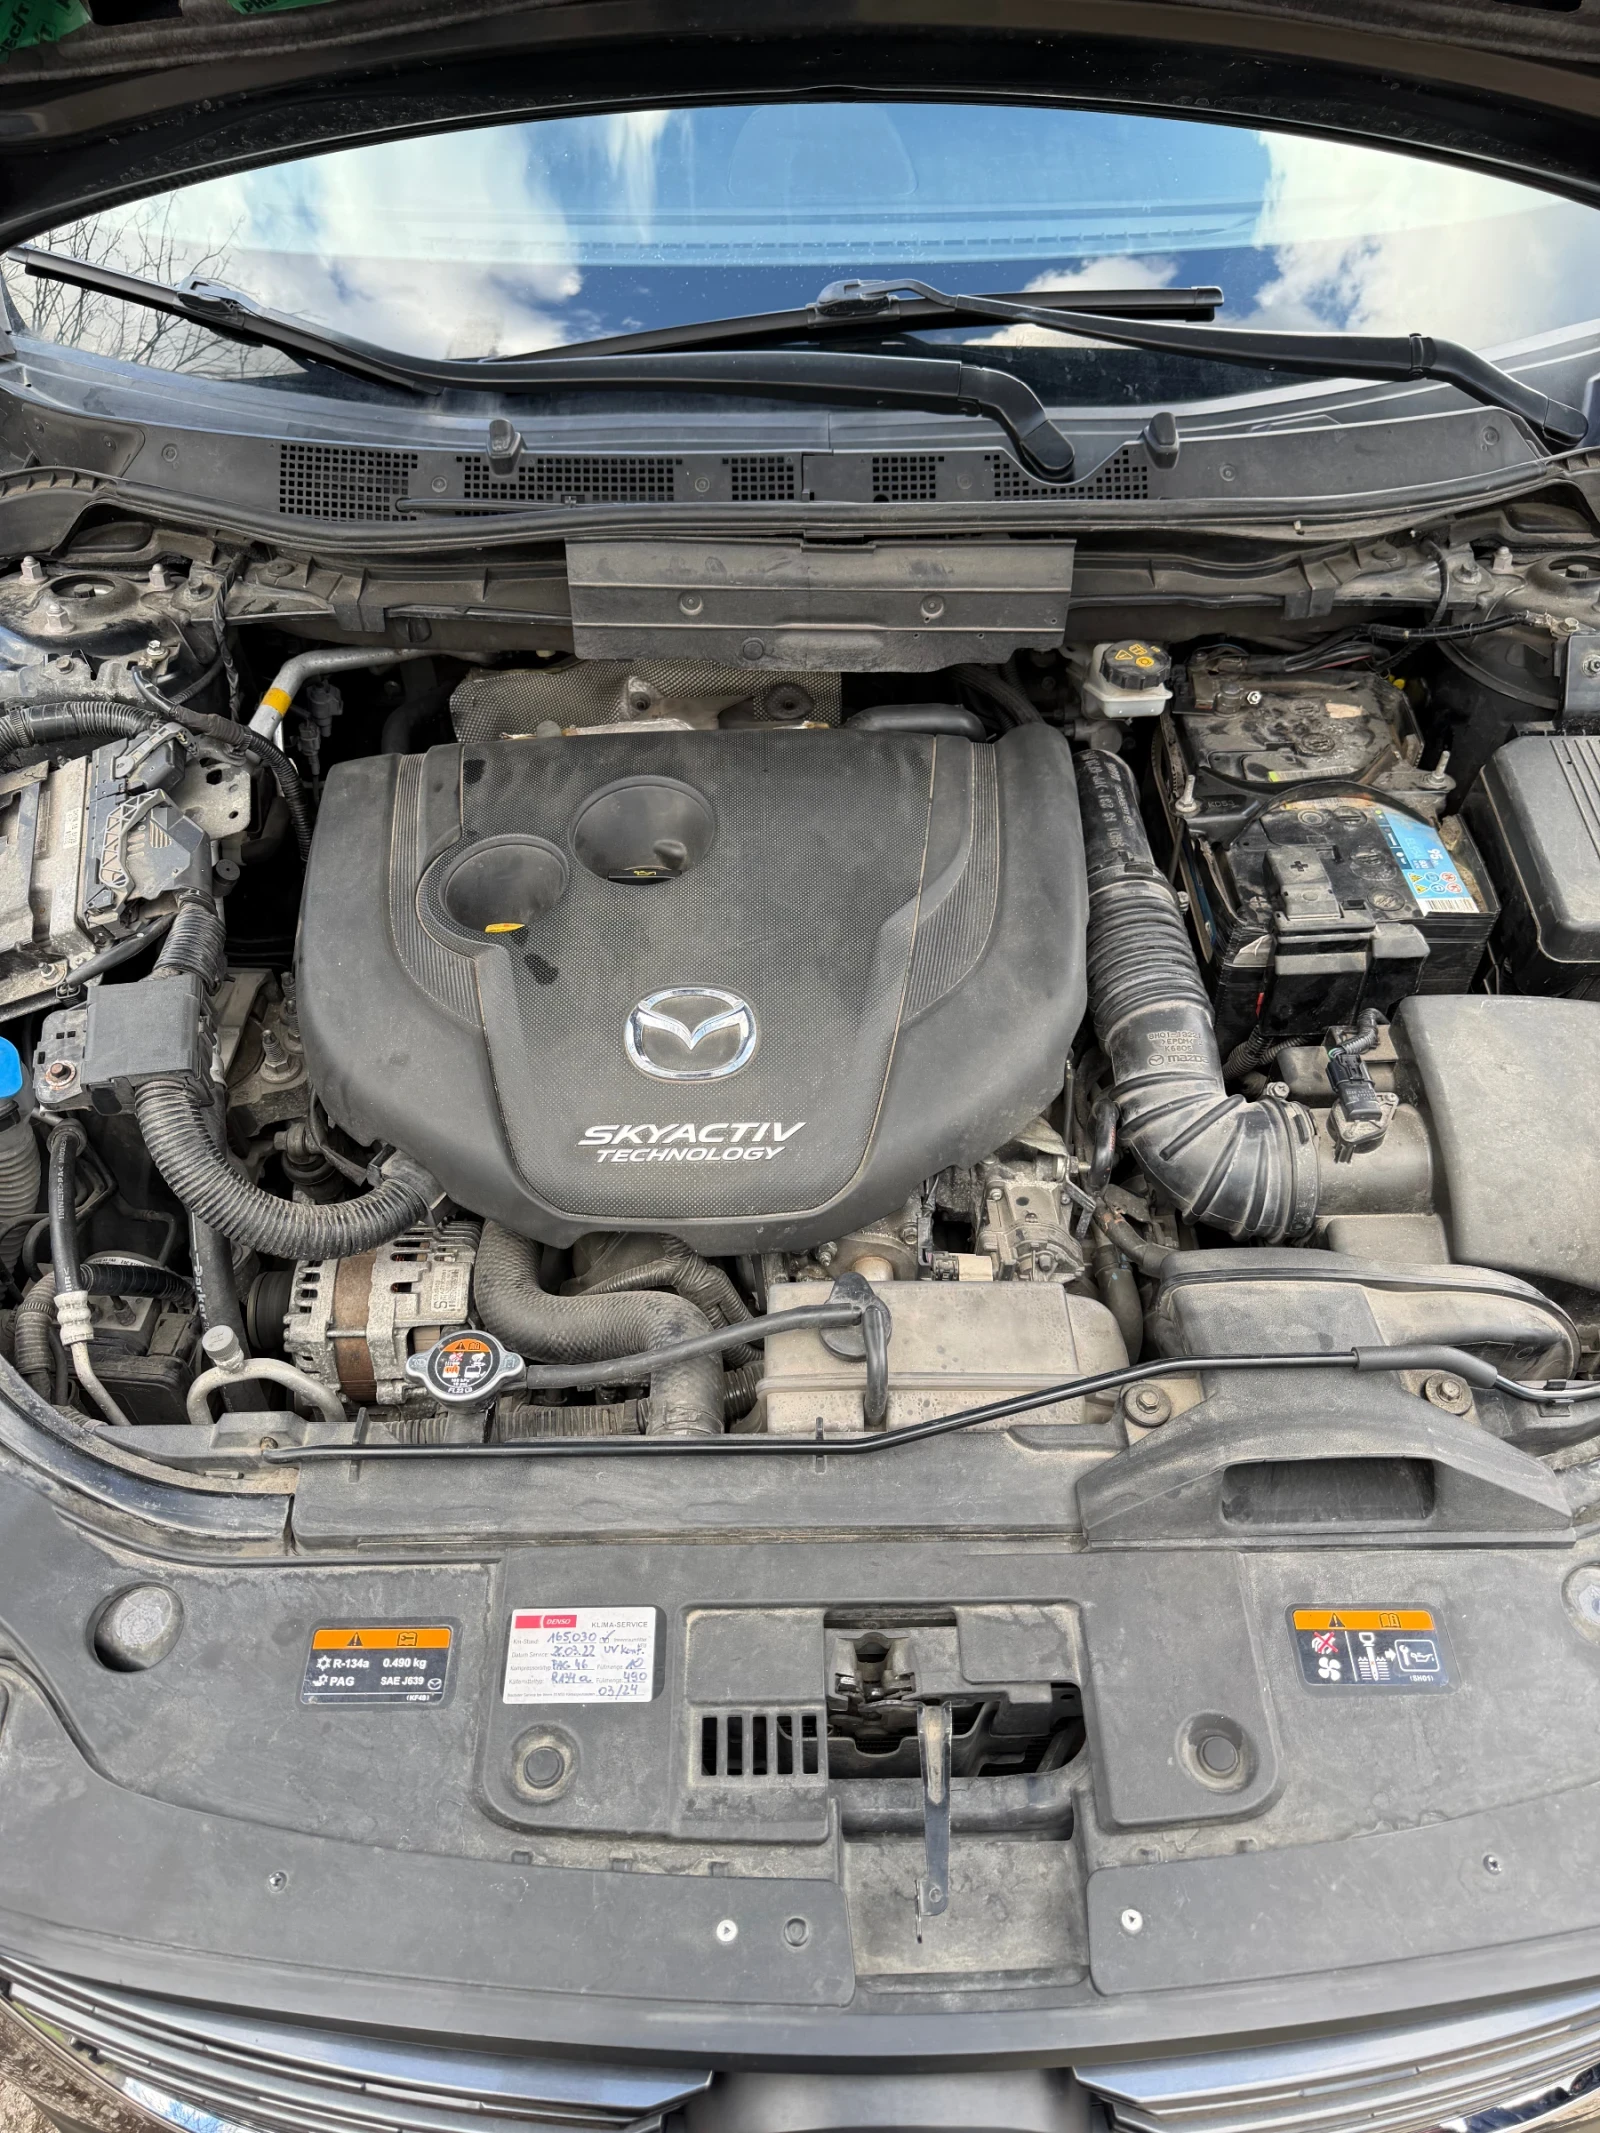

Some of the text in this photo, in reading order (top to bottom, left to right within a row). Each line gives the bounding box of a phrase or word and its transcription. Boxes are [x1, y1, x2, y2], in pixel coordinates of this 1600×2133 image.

[576, 1121, 808, 1146] SKYACTIV
[597, 1146, 786, 1163] TECHNOLOGY
[194, 1263, 208, 1320] Parker
[546, 1618, 572, 1626] DENSO
[333, 1658, 427, 1670] R-134a 0.490 kg
[329, 1676, 425, 1687] PAG SAE J639
